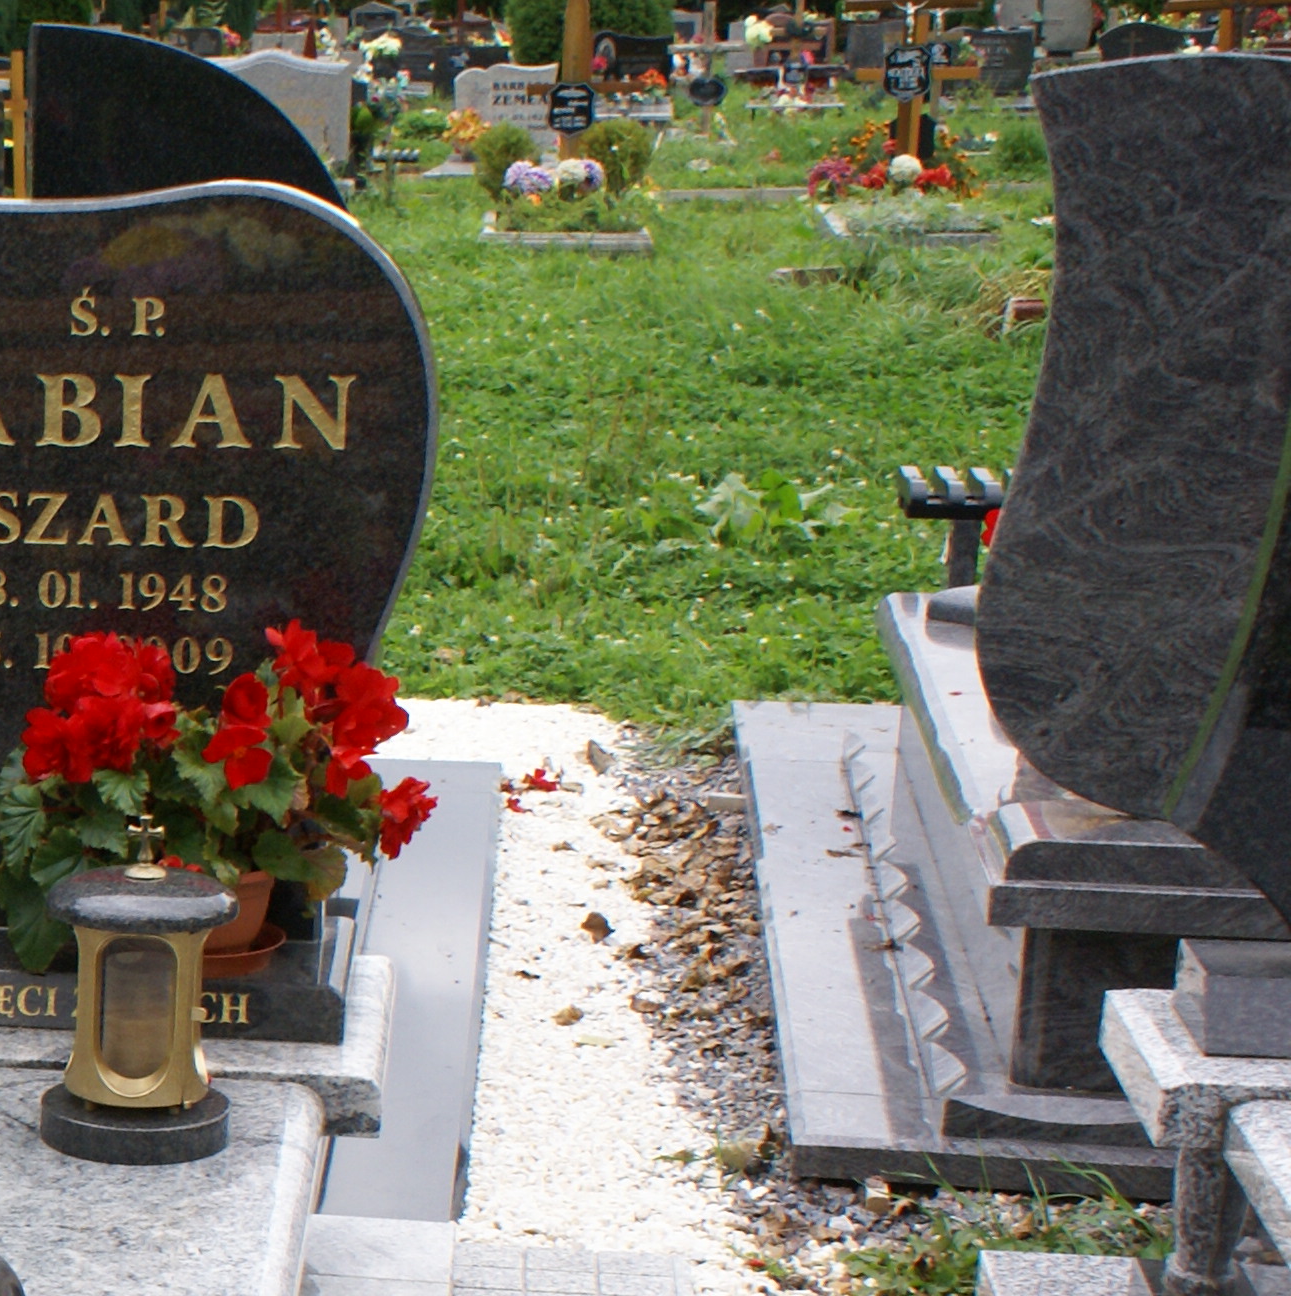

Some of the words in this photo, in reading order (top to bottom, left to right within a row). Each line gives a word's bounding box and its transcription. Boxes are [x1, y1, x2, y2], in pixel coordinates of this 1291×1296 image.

[70, 286, 110, 337] Ś.
[131, 297, 165, 337] P.
[38, 570, 98, 609] 01.
[117, 572, 228, 613] 1948
